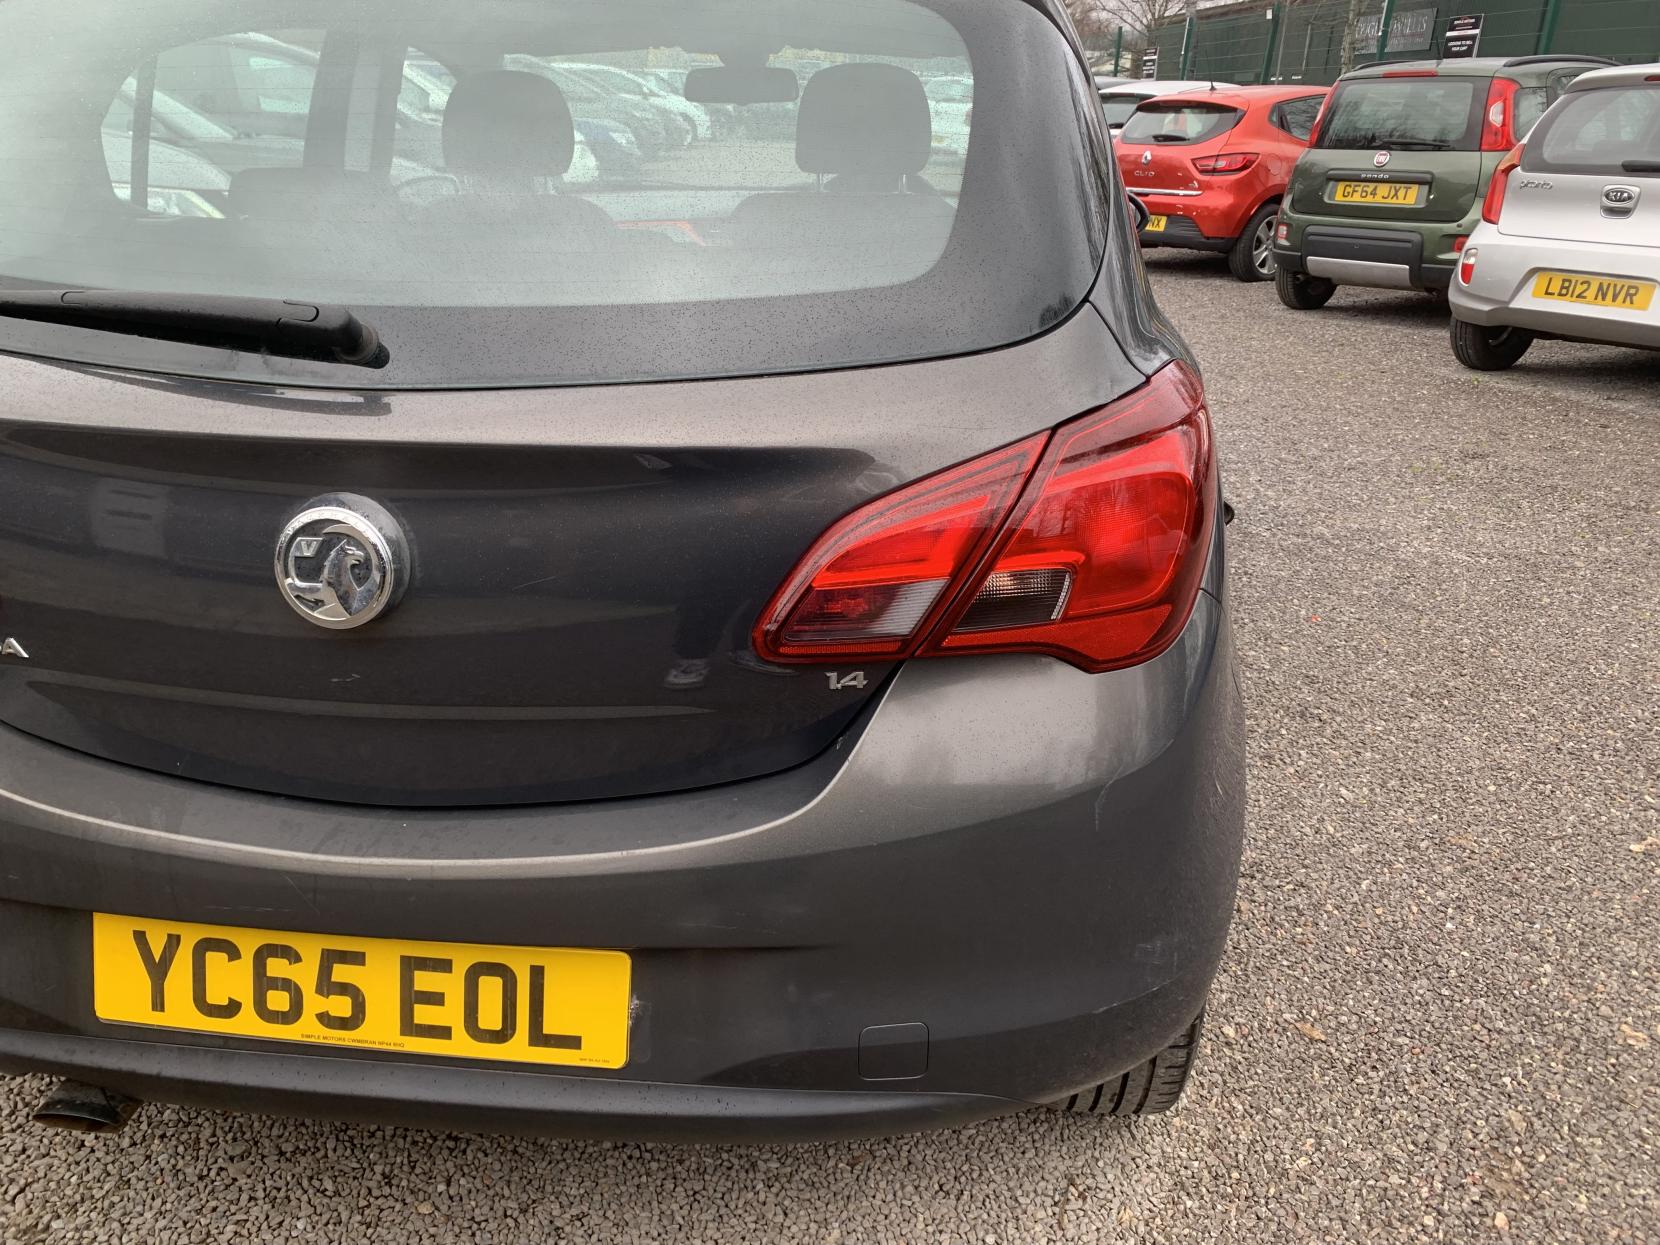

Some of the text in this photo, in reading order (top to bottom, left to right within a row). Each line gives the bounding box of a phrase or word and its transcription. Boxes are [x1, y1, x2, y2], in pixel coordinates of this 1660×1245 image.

[1342, 184, 1412, 200] GF64 JXT
[1608, 191, 1630, 201] KIA
[1544, 277, 1640, 305] LB12 NVR
[0, 637, 29, 658] A
[132, 929, 583, 1051] YC65 EOL
[322, 1035, 346, 1043] MOTORS
